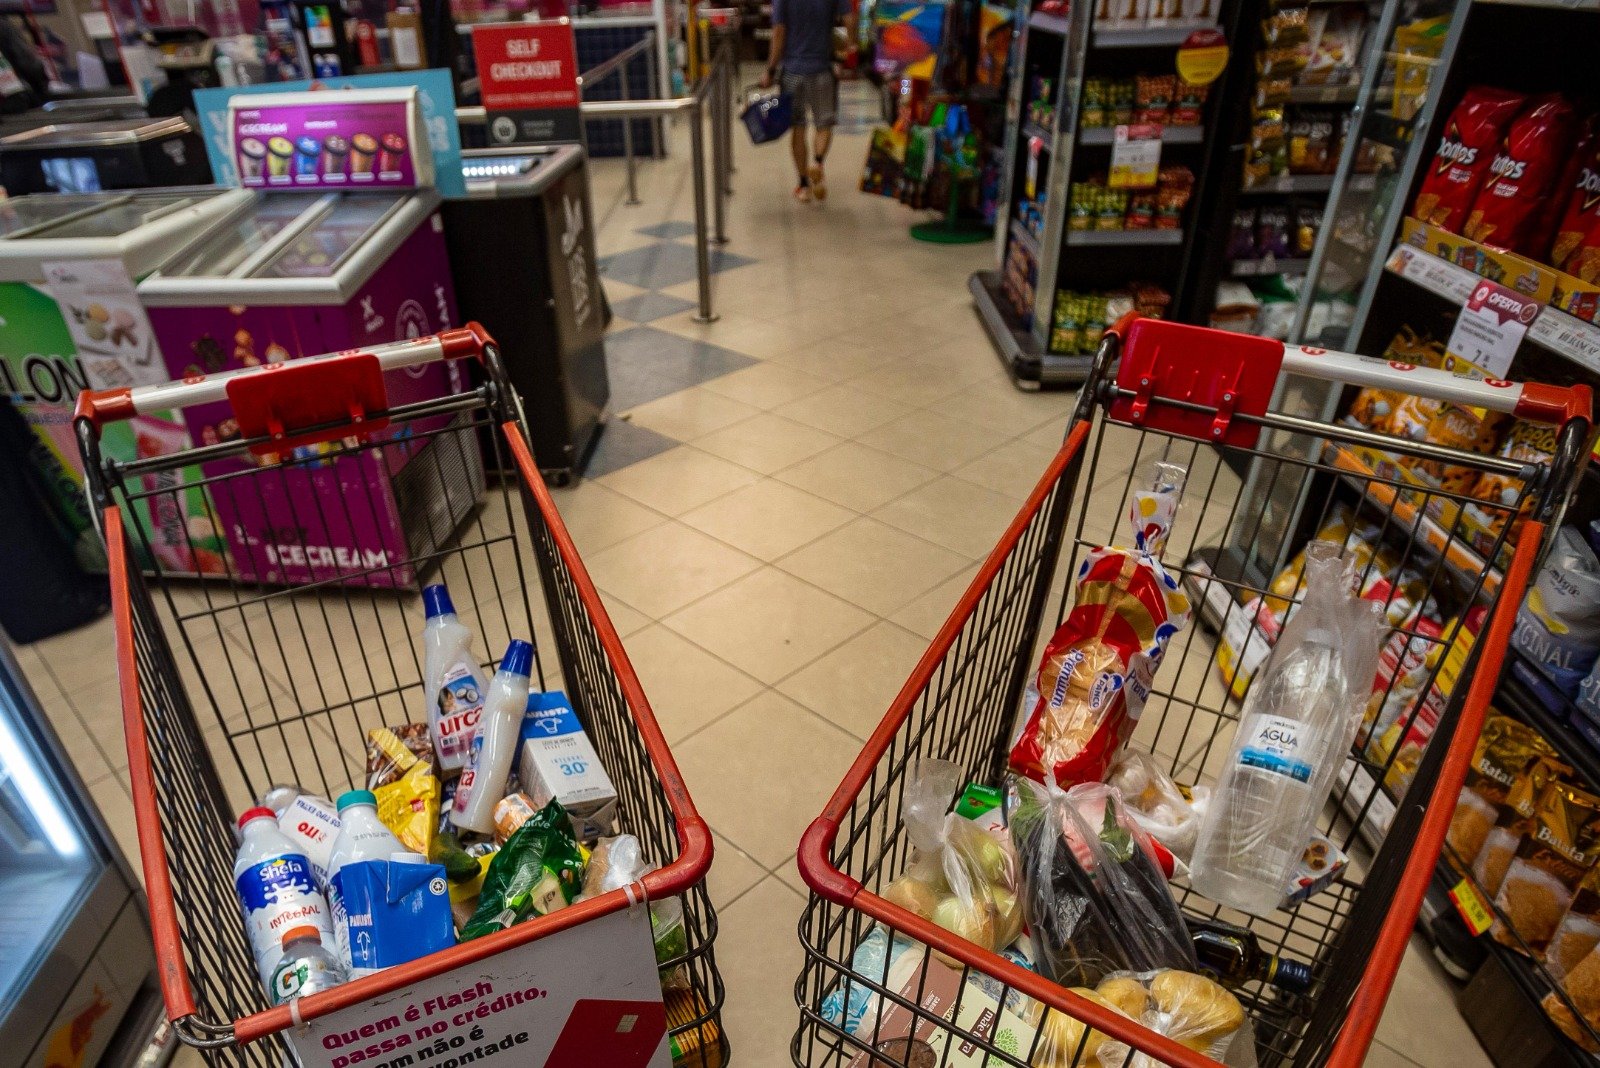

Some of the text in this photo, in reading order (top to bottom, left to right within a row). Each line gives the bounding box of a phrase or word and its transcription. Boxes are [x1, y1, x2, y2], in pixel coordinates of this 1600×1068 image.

[505, 38, 540, 58] SELF
[489, 60, 562, 82] CHECKOUT
[1488, 292, 1523, 315] OFERTA
[265, 544, 391, 570] ICECREAM
[1051, 648, 1086, 709] Premium
[1092, 679, 1106, 709] PANCO
[1259, 726, 1299, 749] ÁGUA
[523, 818, 551, 830] ative
[270, 904, 321, 931] INTEGRAL
[322, 981, 494, 1050] Quem é Flash
[331, 986, 548, 1068] passa no crédito,
[970, 1009, 994, 1032] mãe
[416, 1033, 466, 1062] não
[469, 1024, 485, 1042] é
[425, 1031, 530, 1068] vontade
